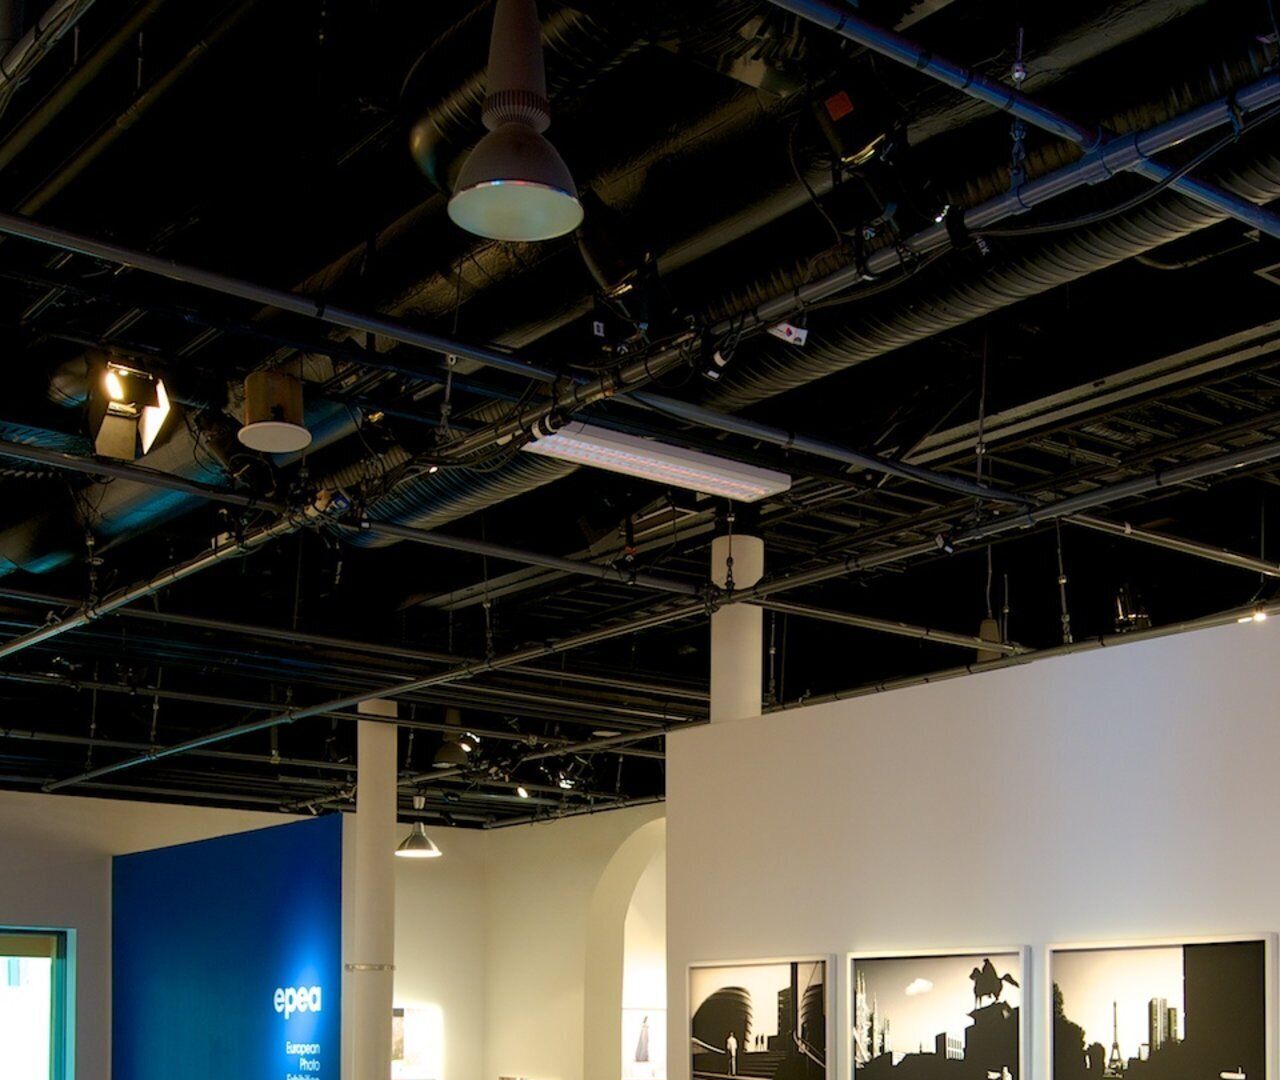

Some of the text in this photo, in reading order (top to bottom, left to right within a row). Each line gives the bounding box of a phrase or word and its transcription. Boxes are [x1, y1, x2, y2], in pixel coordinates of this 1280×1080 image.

[273, 985, 322, 1019] epea
[286, 1041, 320, 1056] European
[299, 1058, 320, 1071] Photo
